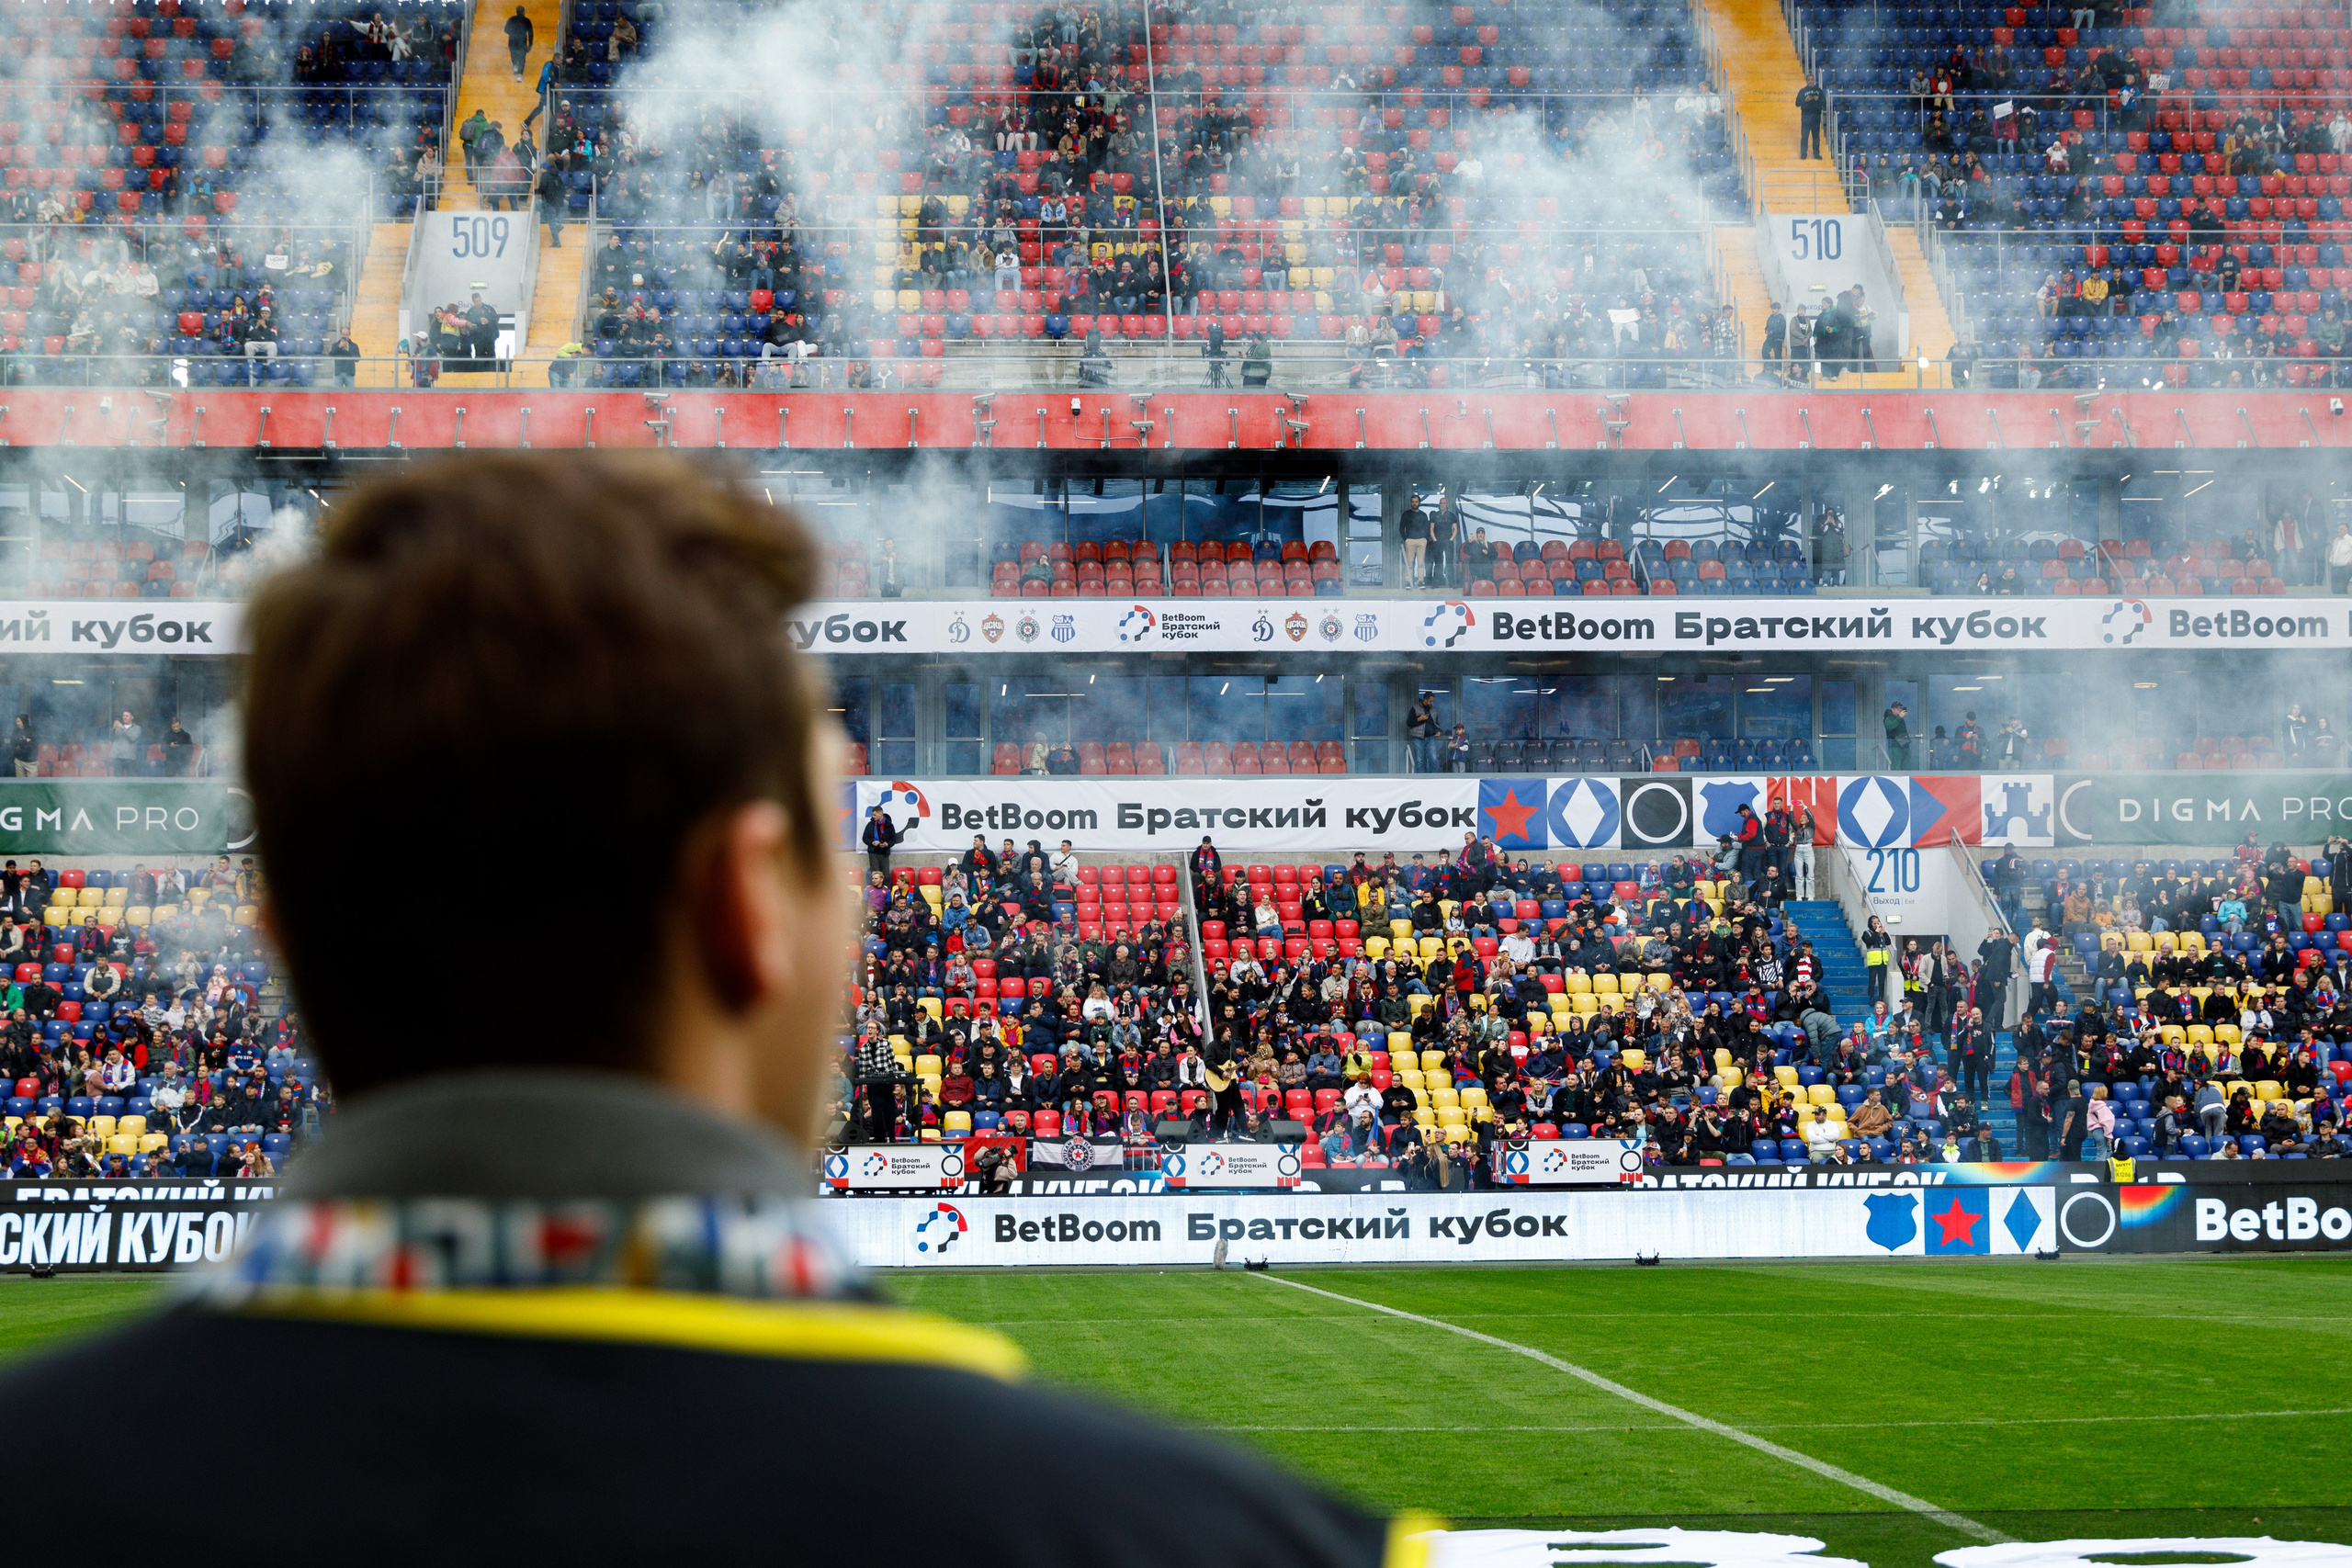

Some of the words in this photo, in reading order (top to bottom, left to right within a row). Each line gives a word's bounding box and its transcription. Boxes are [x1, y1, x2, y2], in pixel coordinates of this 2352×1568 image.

[453, 217, 509, 258] 509
[1792, 219, 1841, 260] 510
[72, 613, 213, 649] кубок
[1161, 614, 1205, 622] BetBoom
[1161, 622, 1220, 632] Братский
[1161, 631, 1198, 640] кубок
[1492, 611, 1655, 641] BetBoom
[1674, 607, 1892, 646] Братский
[1912, 609, 2047, 646] кубок
[2169, 609, 2328, 637] BetBoom
[117, 807, 199, 830] PRO
[941, 803, 1098, 829] BetBoom
[1117, 798, 1327, 835] Братский
[1345, 800, 1476, 834] кубок
[2120, 797, 2262, 822] DIGMA
[1866, 848, 1920, 893] 210
[1872, 897, 1900, 905] Выход
[2266, 921, 2276, 931] 12
[0, 1204, 112, 1265] СКИЙ
[995, 1213, 1161, 1243] BetBoom
[1188, 1208, 1409, 1242] Братский
[1430, 1208, 1567, 1245] кубок
[2195, 1197, 2352, 1241] BetBo
